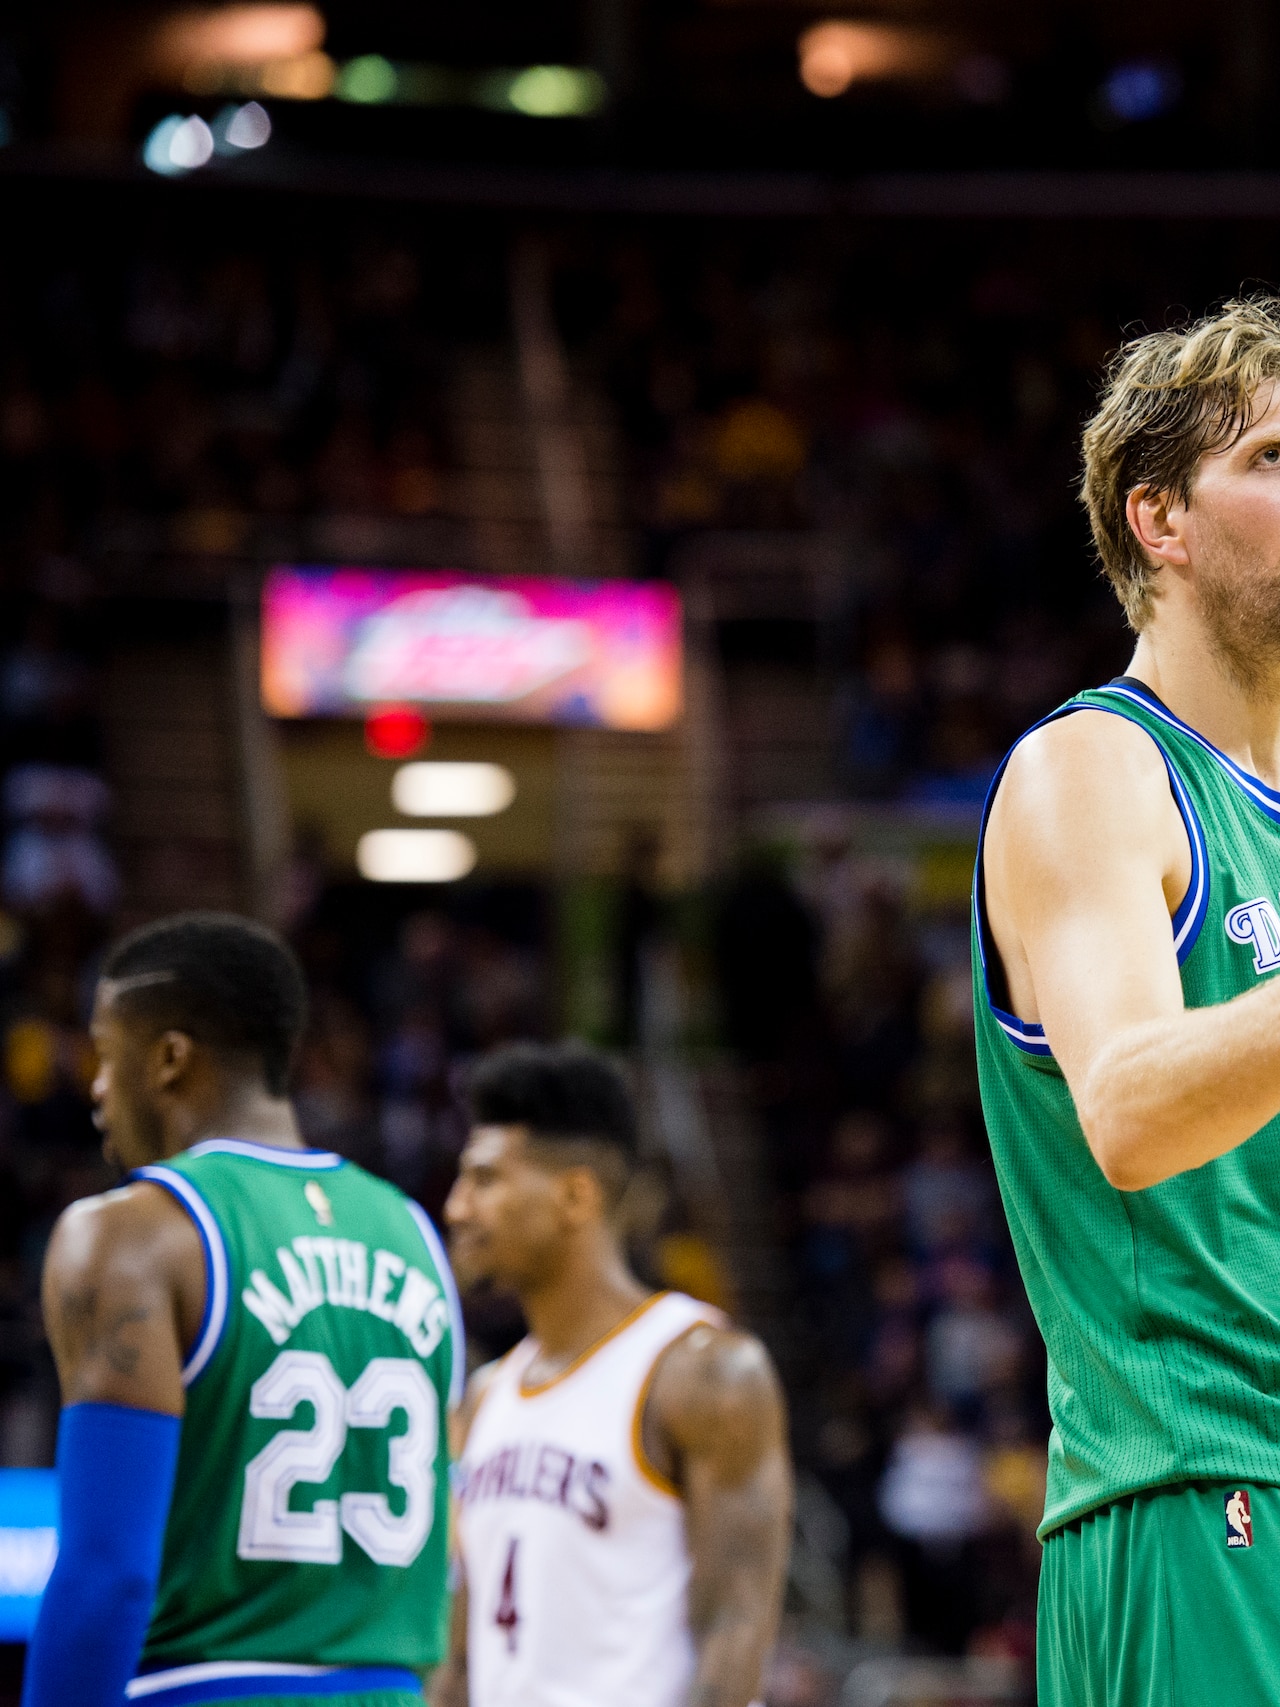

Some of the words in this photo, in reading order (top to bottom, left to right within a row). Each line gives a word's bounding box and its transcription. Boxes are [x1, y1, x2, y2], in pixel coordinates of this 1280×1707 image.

[236, 1349, 439, 1568] 23
[496, 1536, 521, 1655] 4
[1227, 1535, 1246, 1546] NBA
